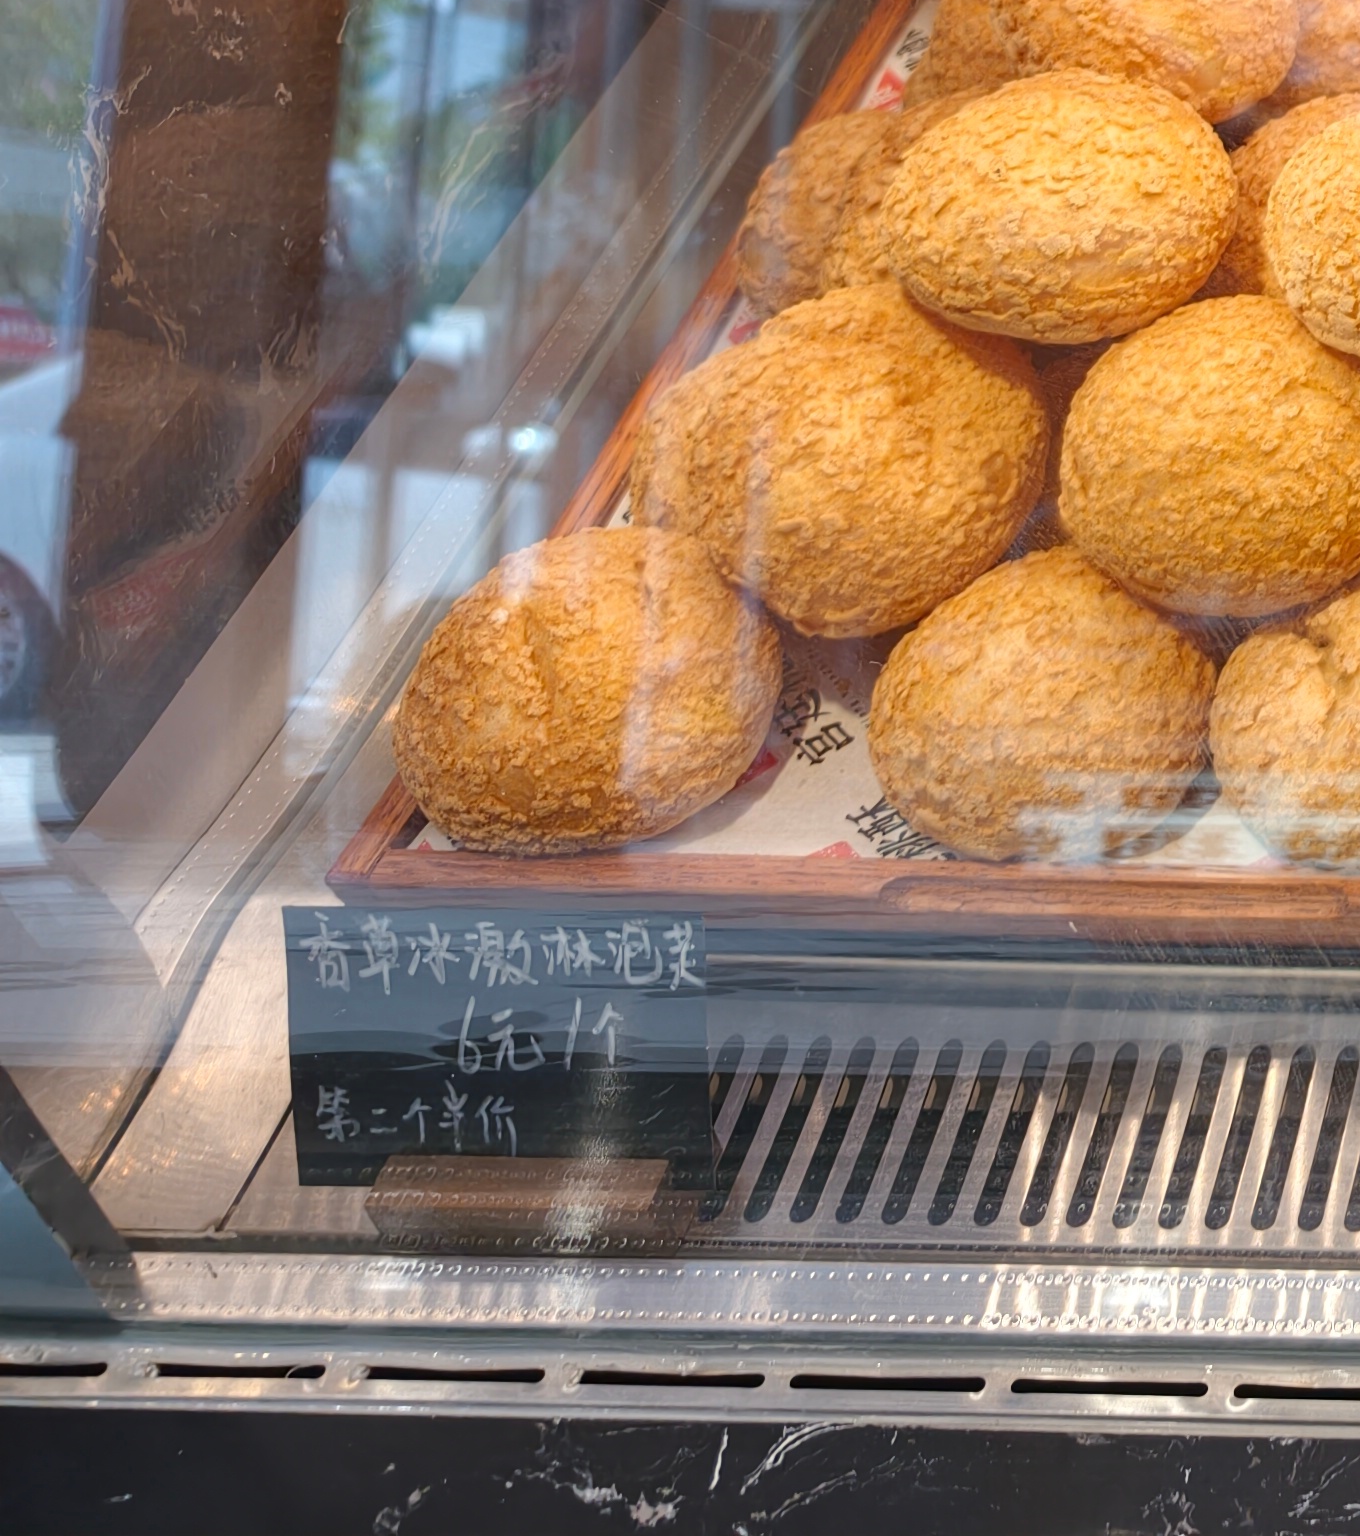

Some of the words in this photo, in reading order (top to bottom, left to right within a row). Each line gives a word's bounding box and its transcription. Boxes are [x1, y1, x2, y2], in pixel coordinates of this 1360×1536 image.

[456, 996, 624, 1075] 6元/个
[315, 1079, 518, 1158] 第二个半价
